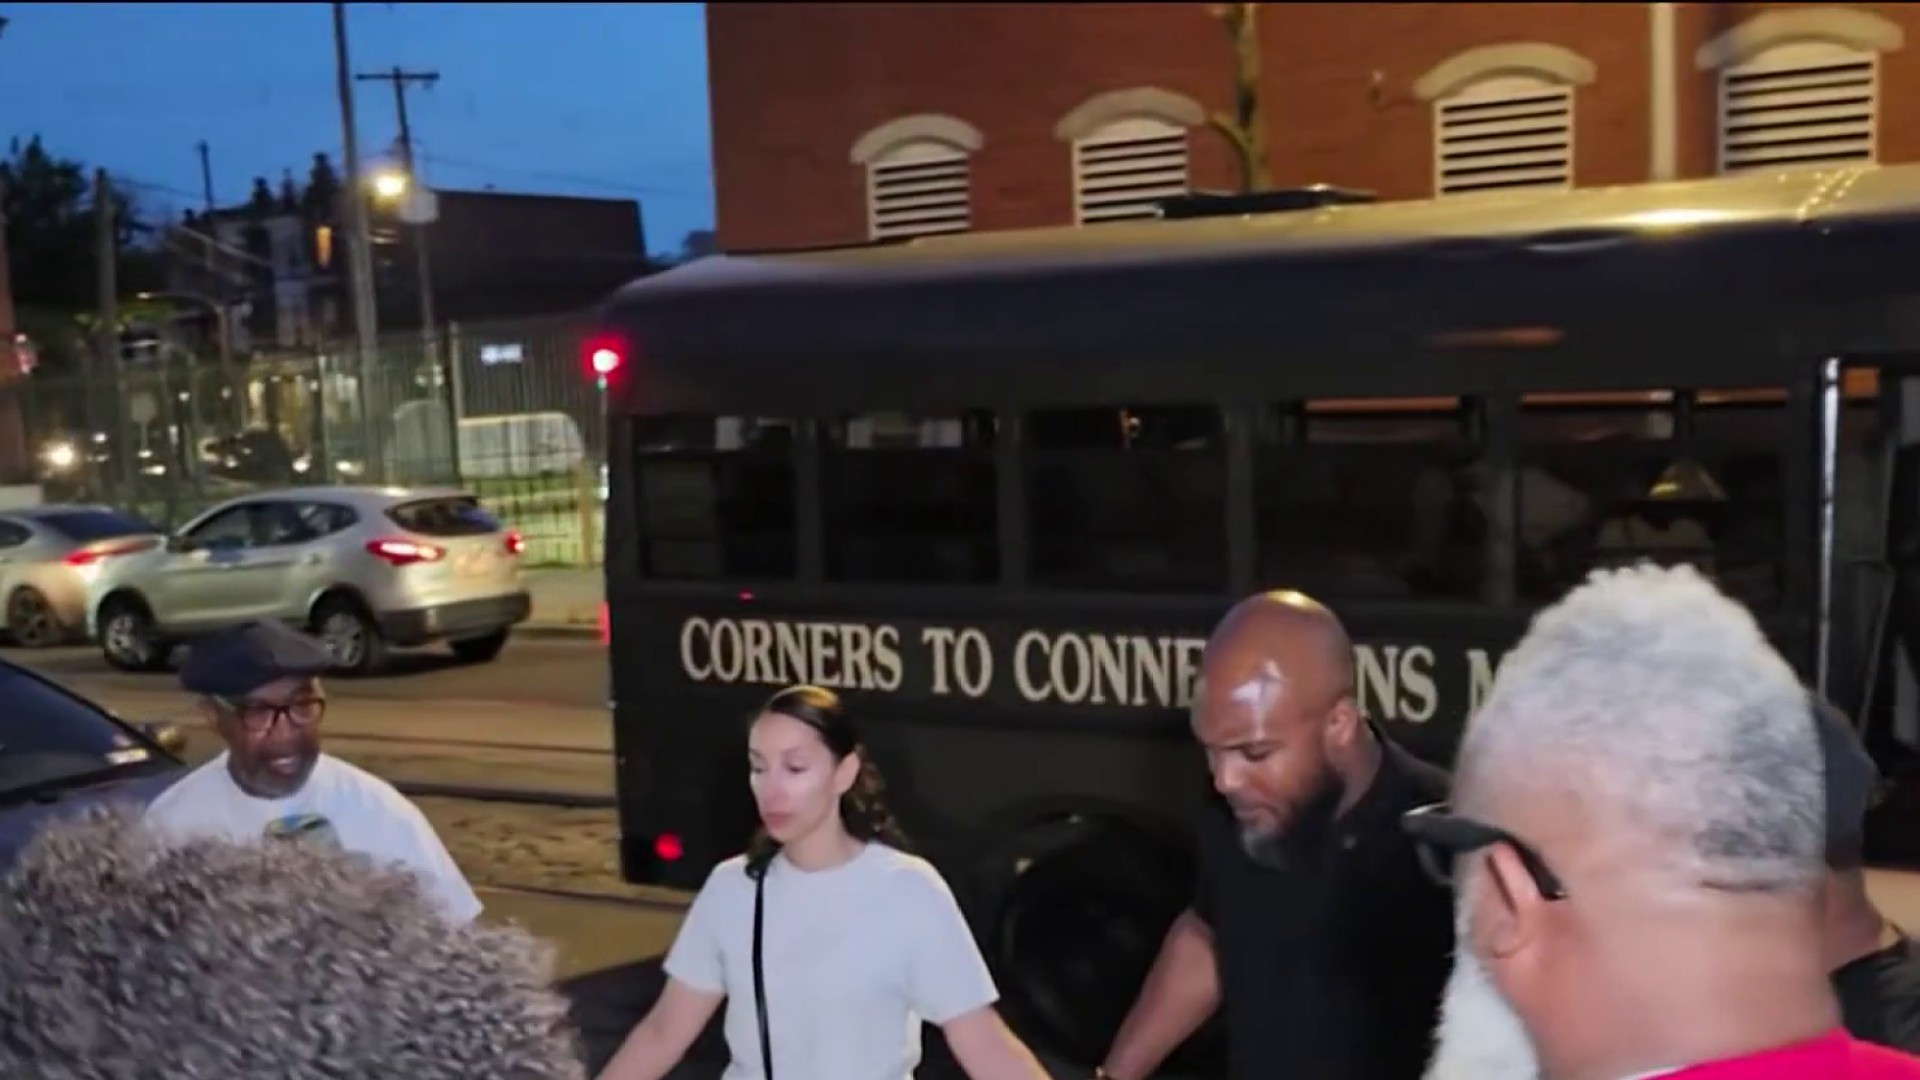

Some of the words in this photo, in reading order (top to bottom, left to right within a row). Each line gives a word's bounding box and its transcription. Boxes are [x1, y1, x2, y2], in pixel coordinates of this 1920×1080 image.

[680, 616, 903, 692] CORNERS
[922, 627, 993, 697] TO
[1013, 631, 1439, 723] CONNENS
